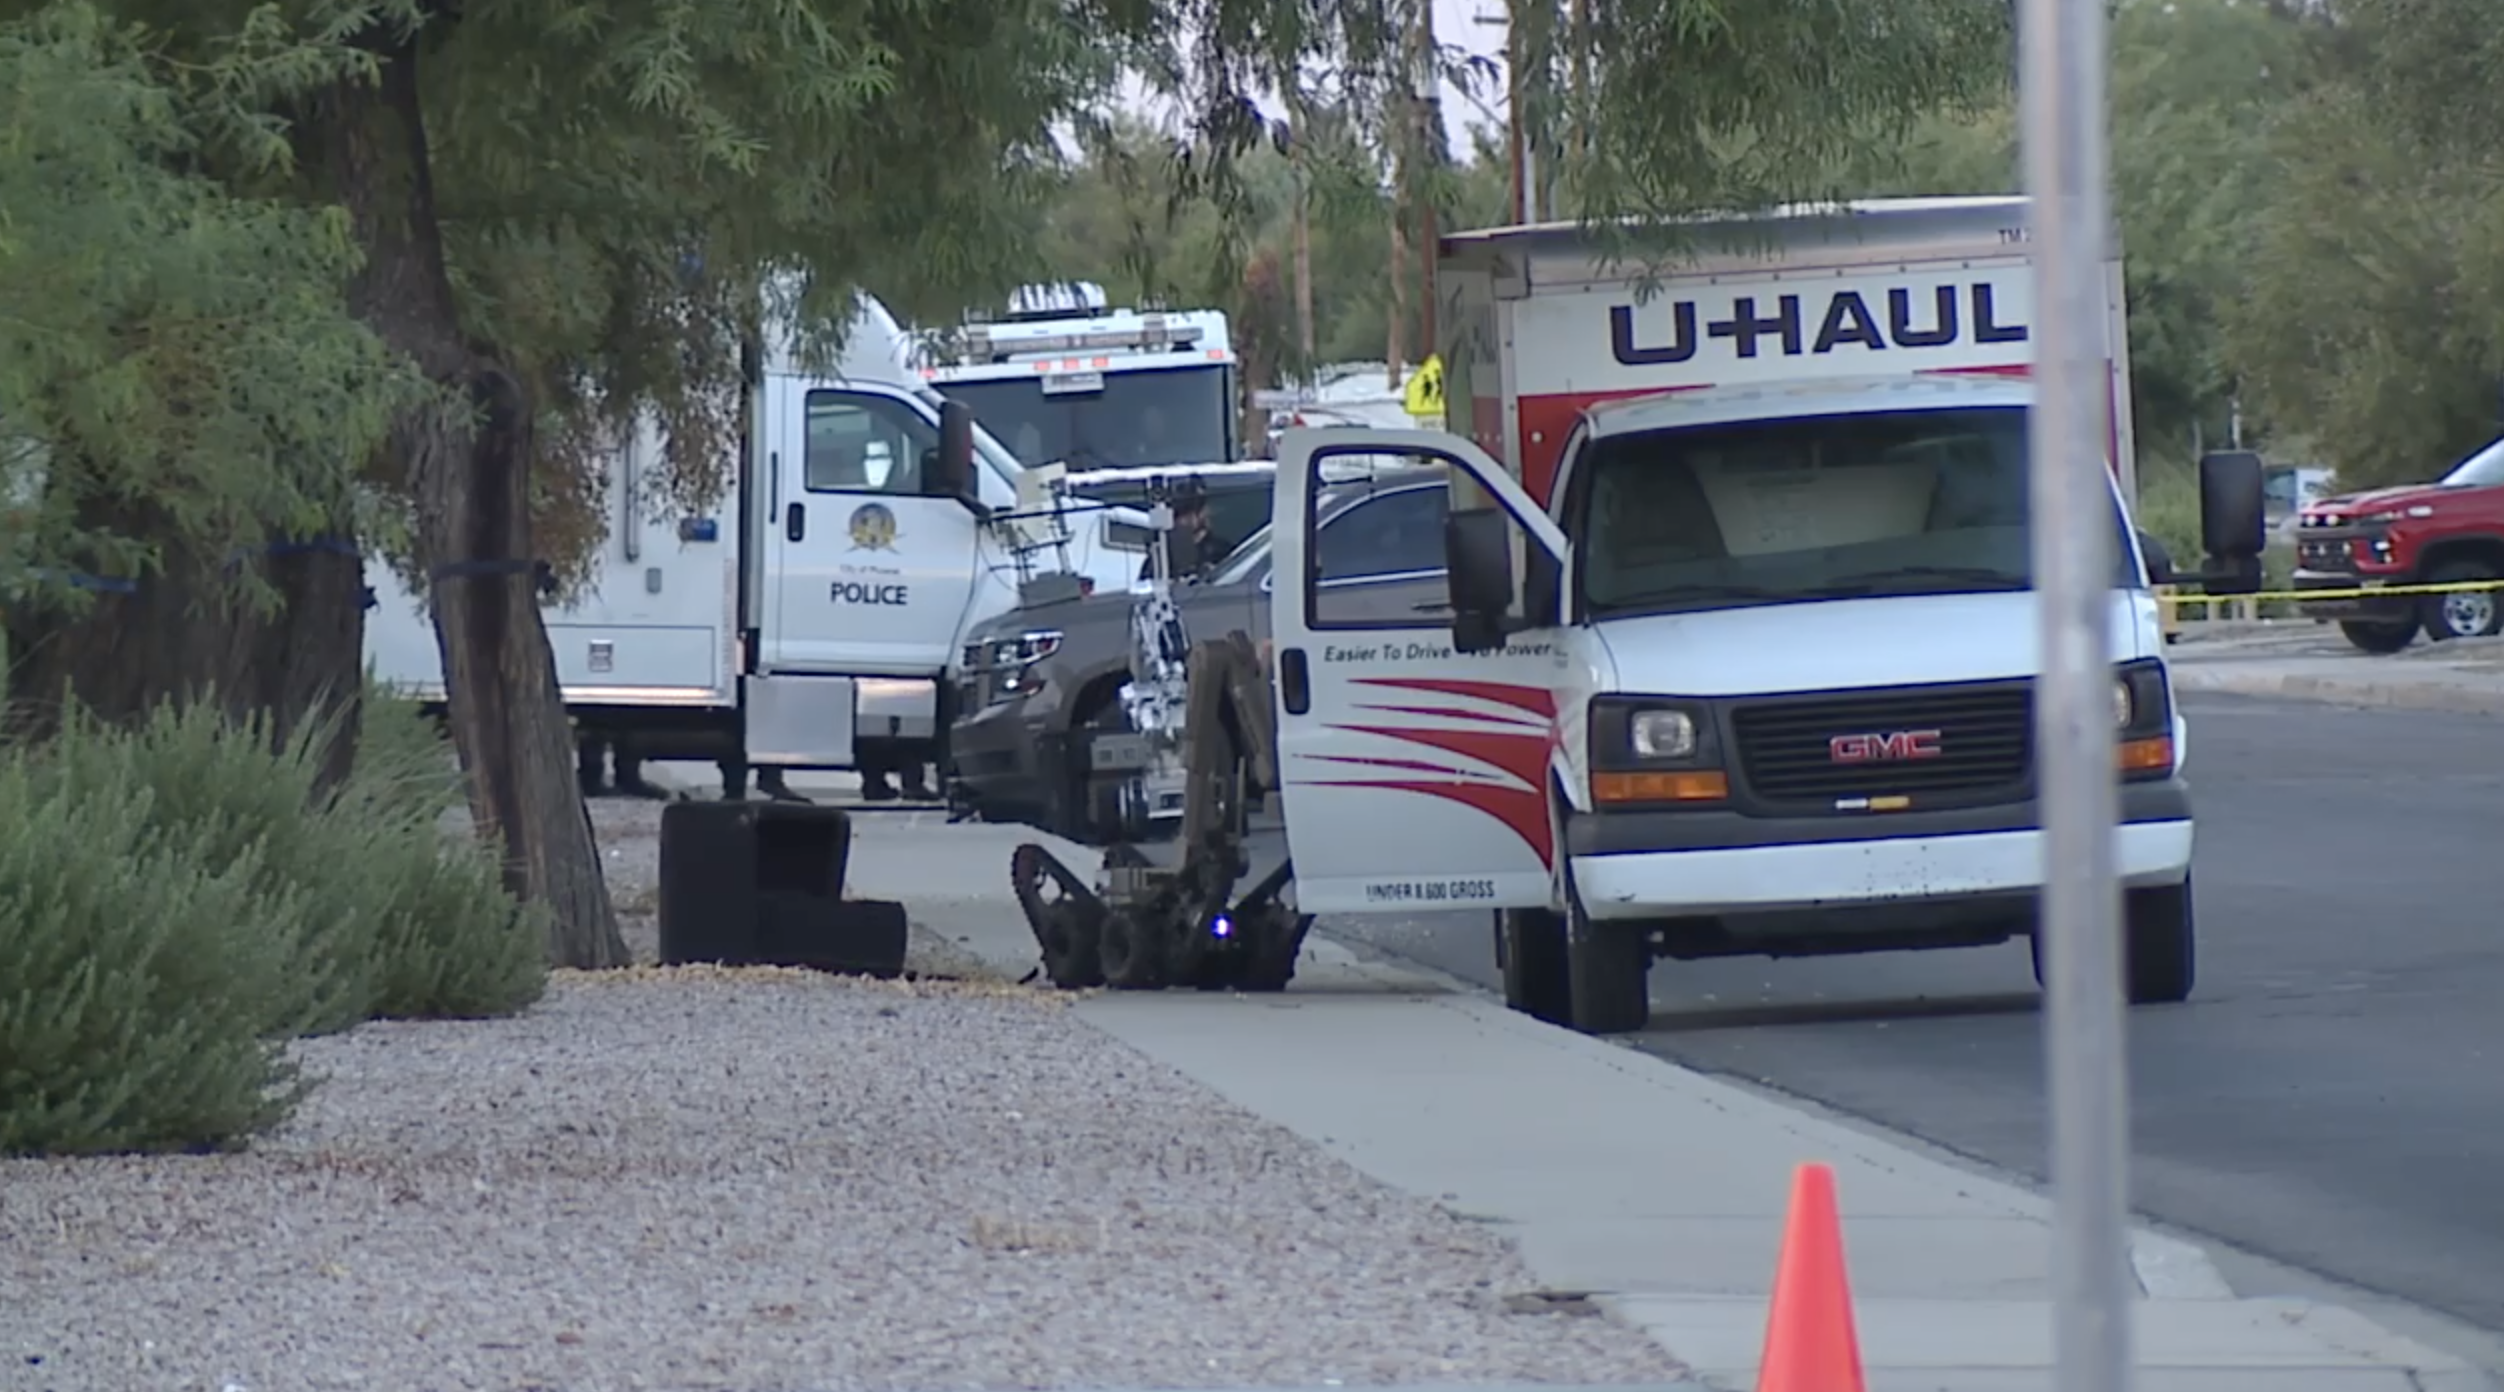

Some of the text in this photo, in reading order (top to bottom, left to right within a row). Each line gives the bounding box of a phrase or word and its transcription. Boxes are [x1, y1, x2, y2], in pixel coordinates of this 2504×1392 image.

[1998, 228, 2021, 245] TM
[1609, 282, 2029, 366] U-HAUL
[831, 581, 908, 606] POLICE
[1324, 645, 1377, 662] Easier
[1383, 643, 1402, 660] To
[1406, 641, 1451, 660] Drive
[1830, 729, 1942, 765] GMC
[1365, 882, 1412, 901] UNDER
[1449, 880, 1496, 899] GROSS
